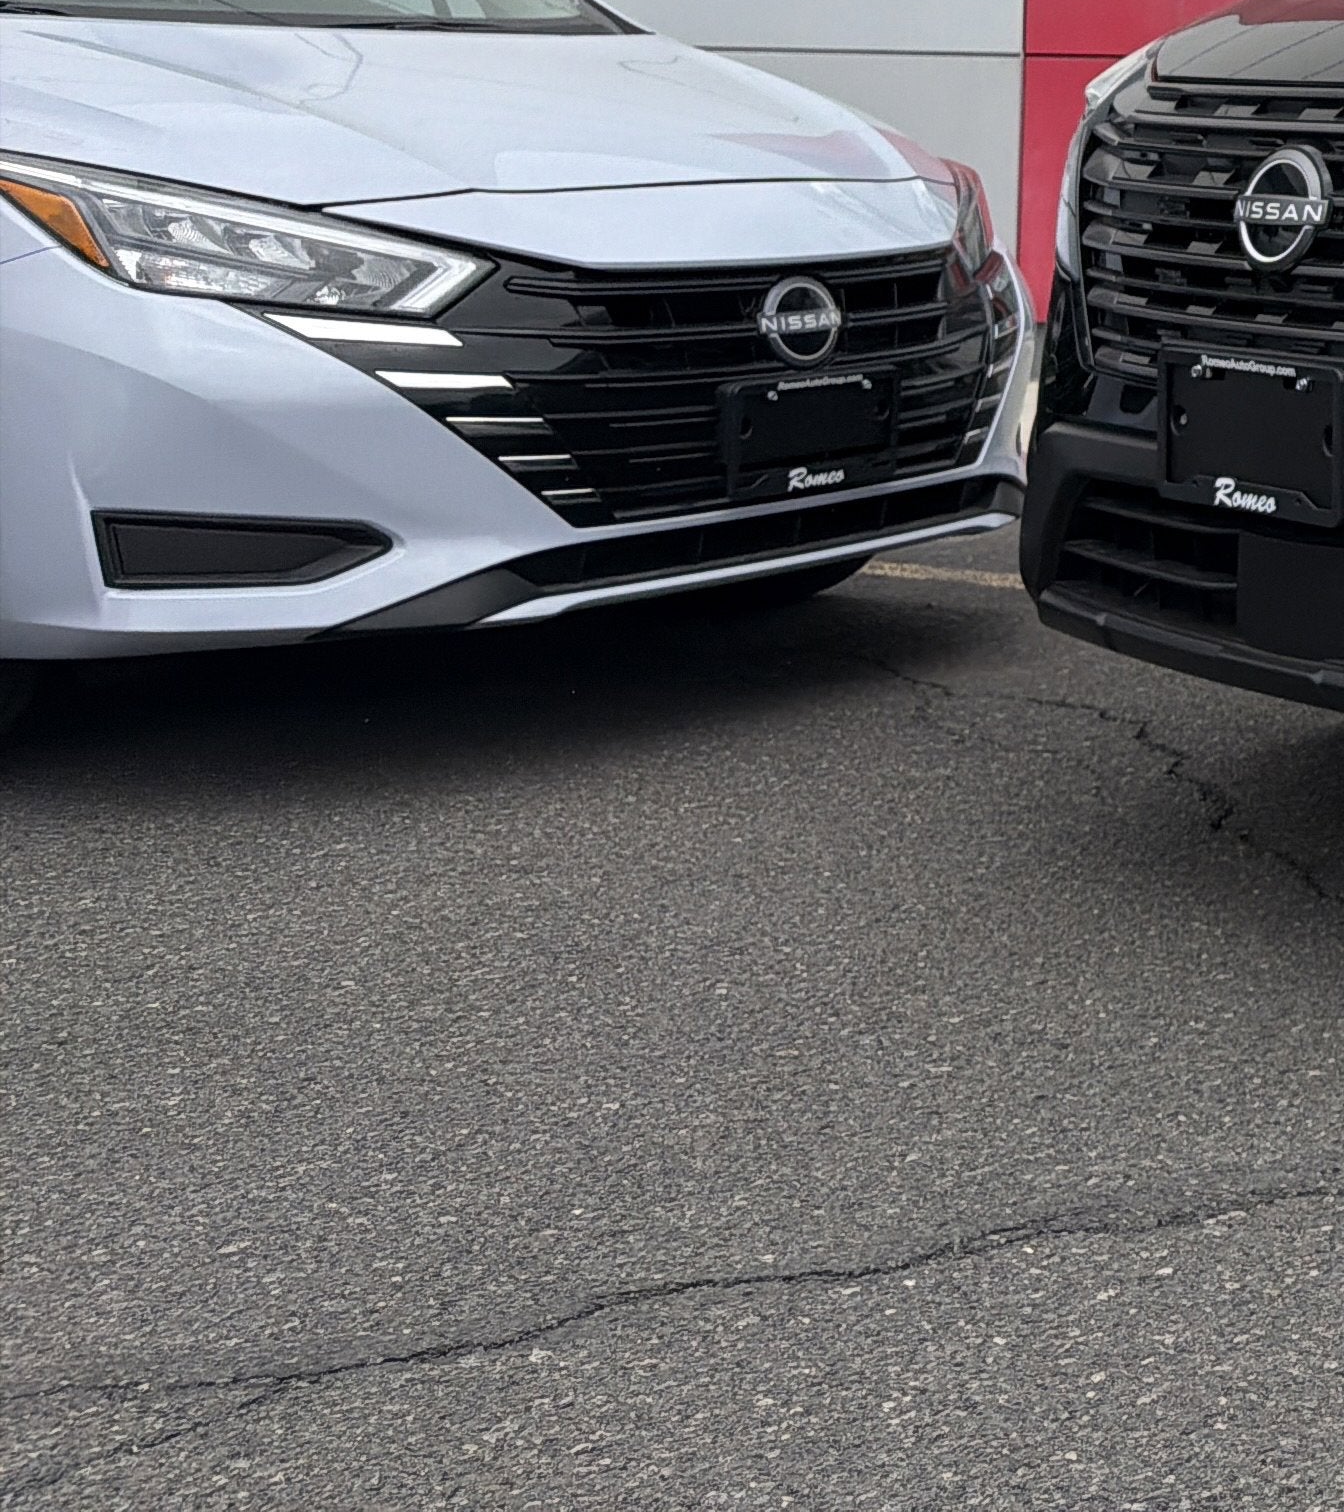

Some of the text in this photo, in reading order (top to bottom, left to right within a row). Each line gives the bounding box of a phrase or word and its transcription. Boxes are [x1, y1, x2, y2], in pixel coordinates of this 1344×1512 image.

[1235, 198, 1323, 222] NISSAN
[761, 311, 841, 333] NISSAN
[1201, 354, 1297, 378] RomeoAutoGroup.com
[787, 466, 845, 493] Romeo
[1213, 477, 1277, 514] Romeo
